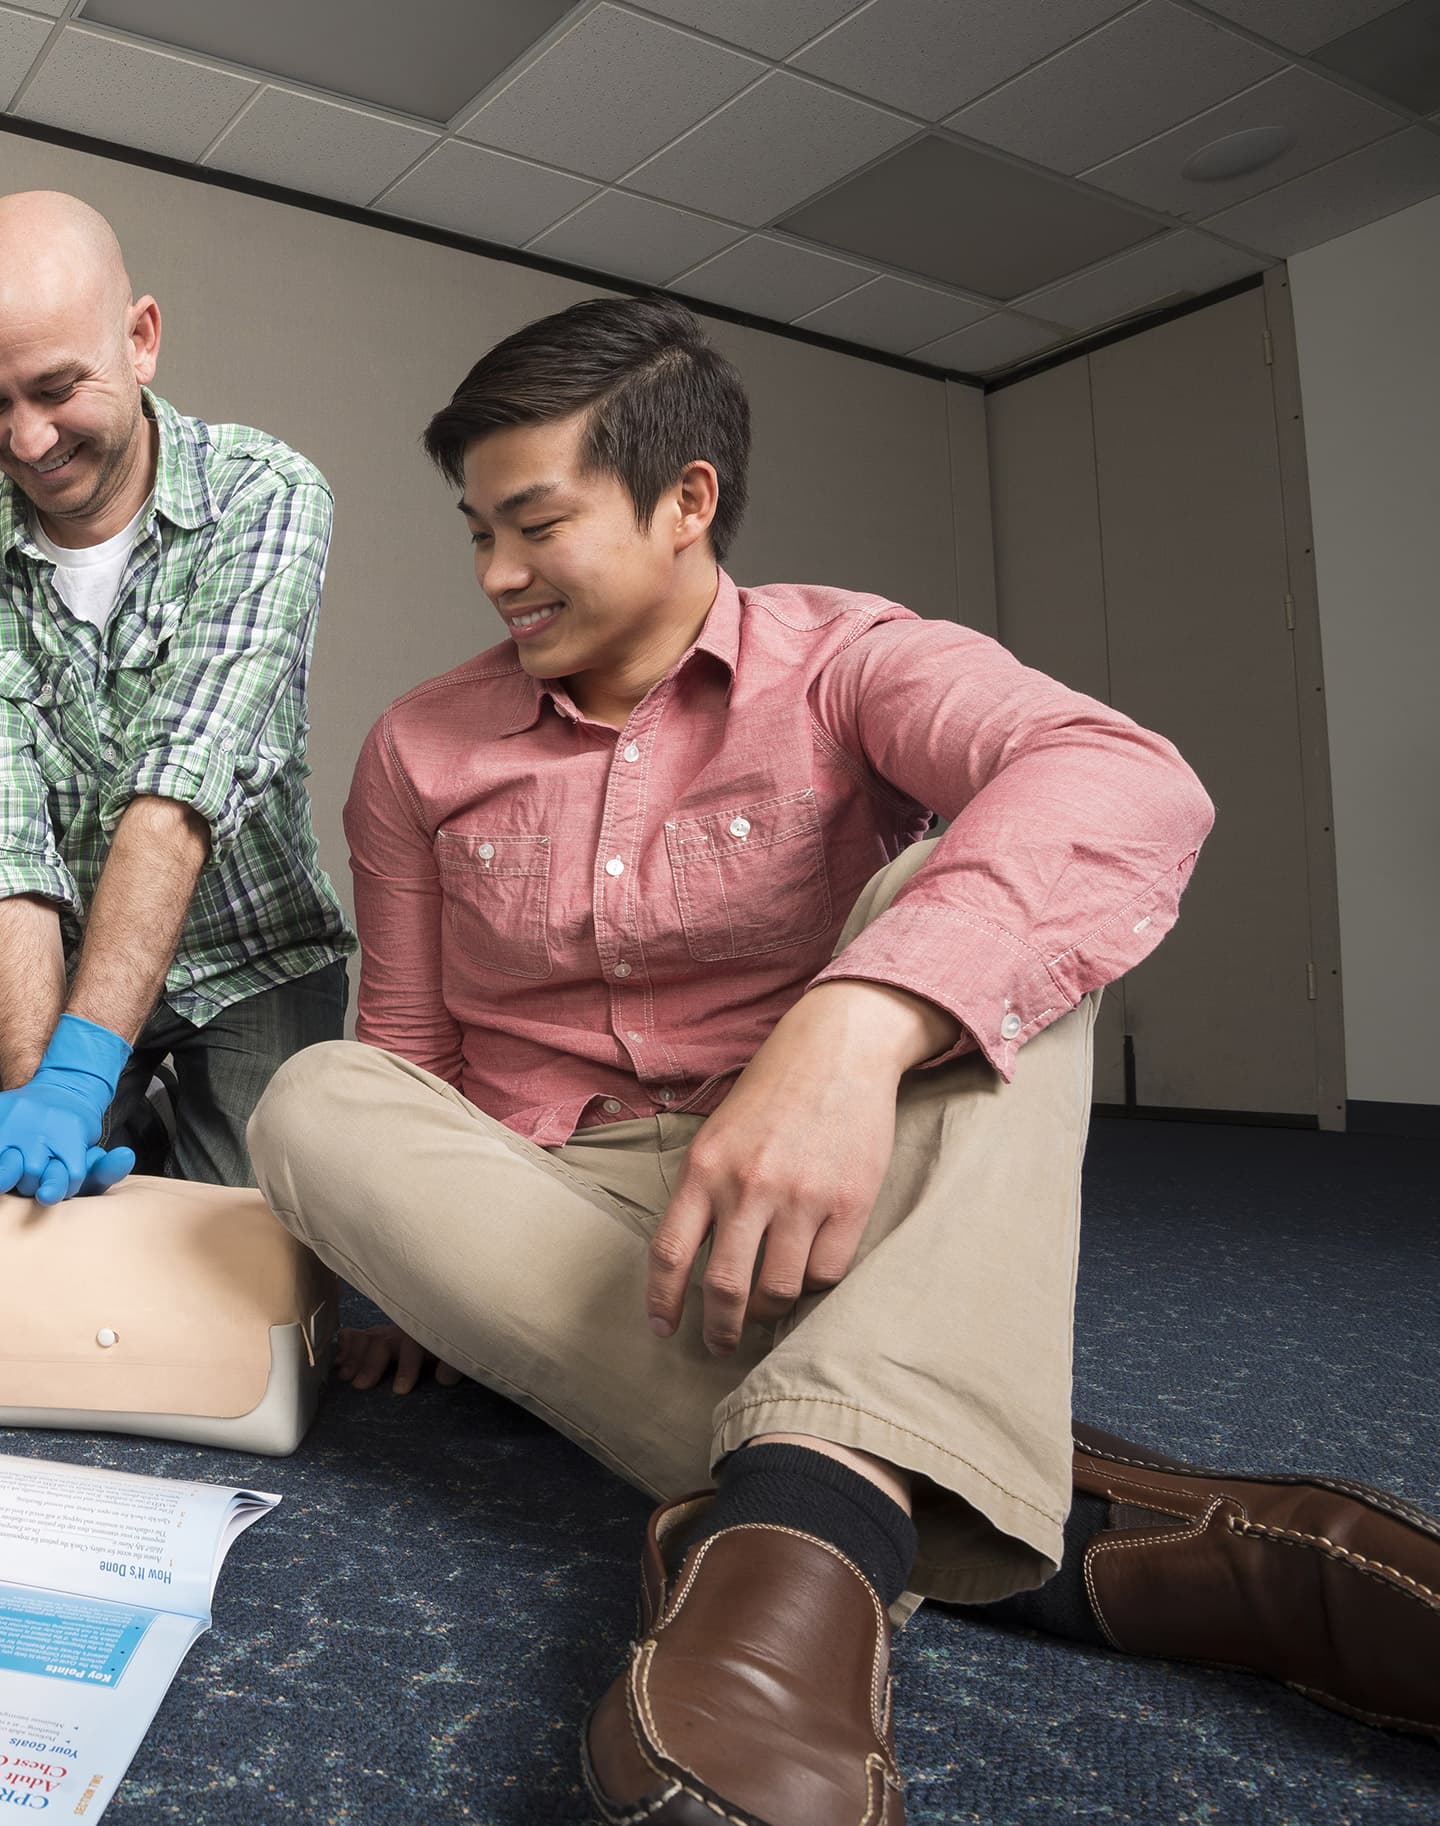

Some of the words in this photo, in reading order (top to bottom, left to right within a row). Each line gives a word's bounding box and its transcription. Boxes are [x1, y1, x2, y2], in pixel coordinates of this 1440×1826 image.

[99, 1561, 126, 1576] Done
[129, 1565, 145, 1581] It's
[148, 1569, 172, 1584] How
[45, 1664, 86, 1679] Points
[88, 1670, 112, 1683] Key
[8, 1736, 50, 1752] Goals
[49, 1743, 80, 1760] Your
[12, 1758, 68, 1778] Chest
[4, 1772, 62, 1793] Adult
